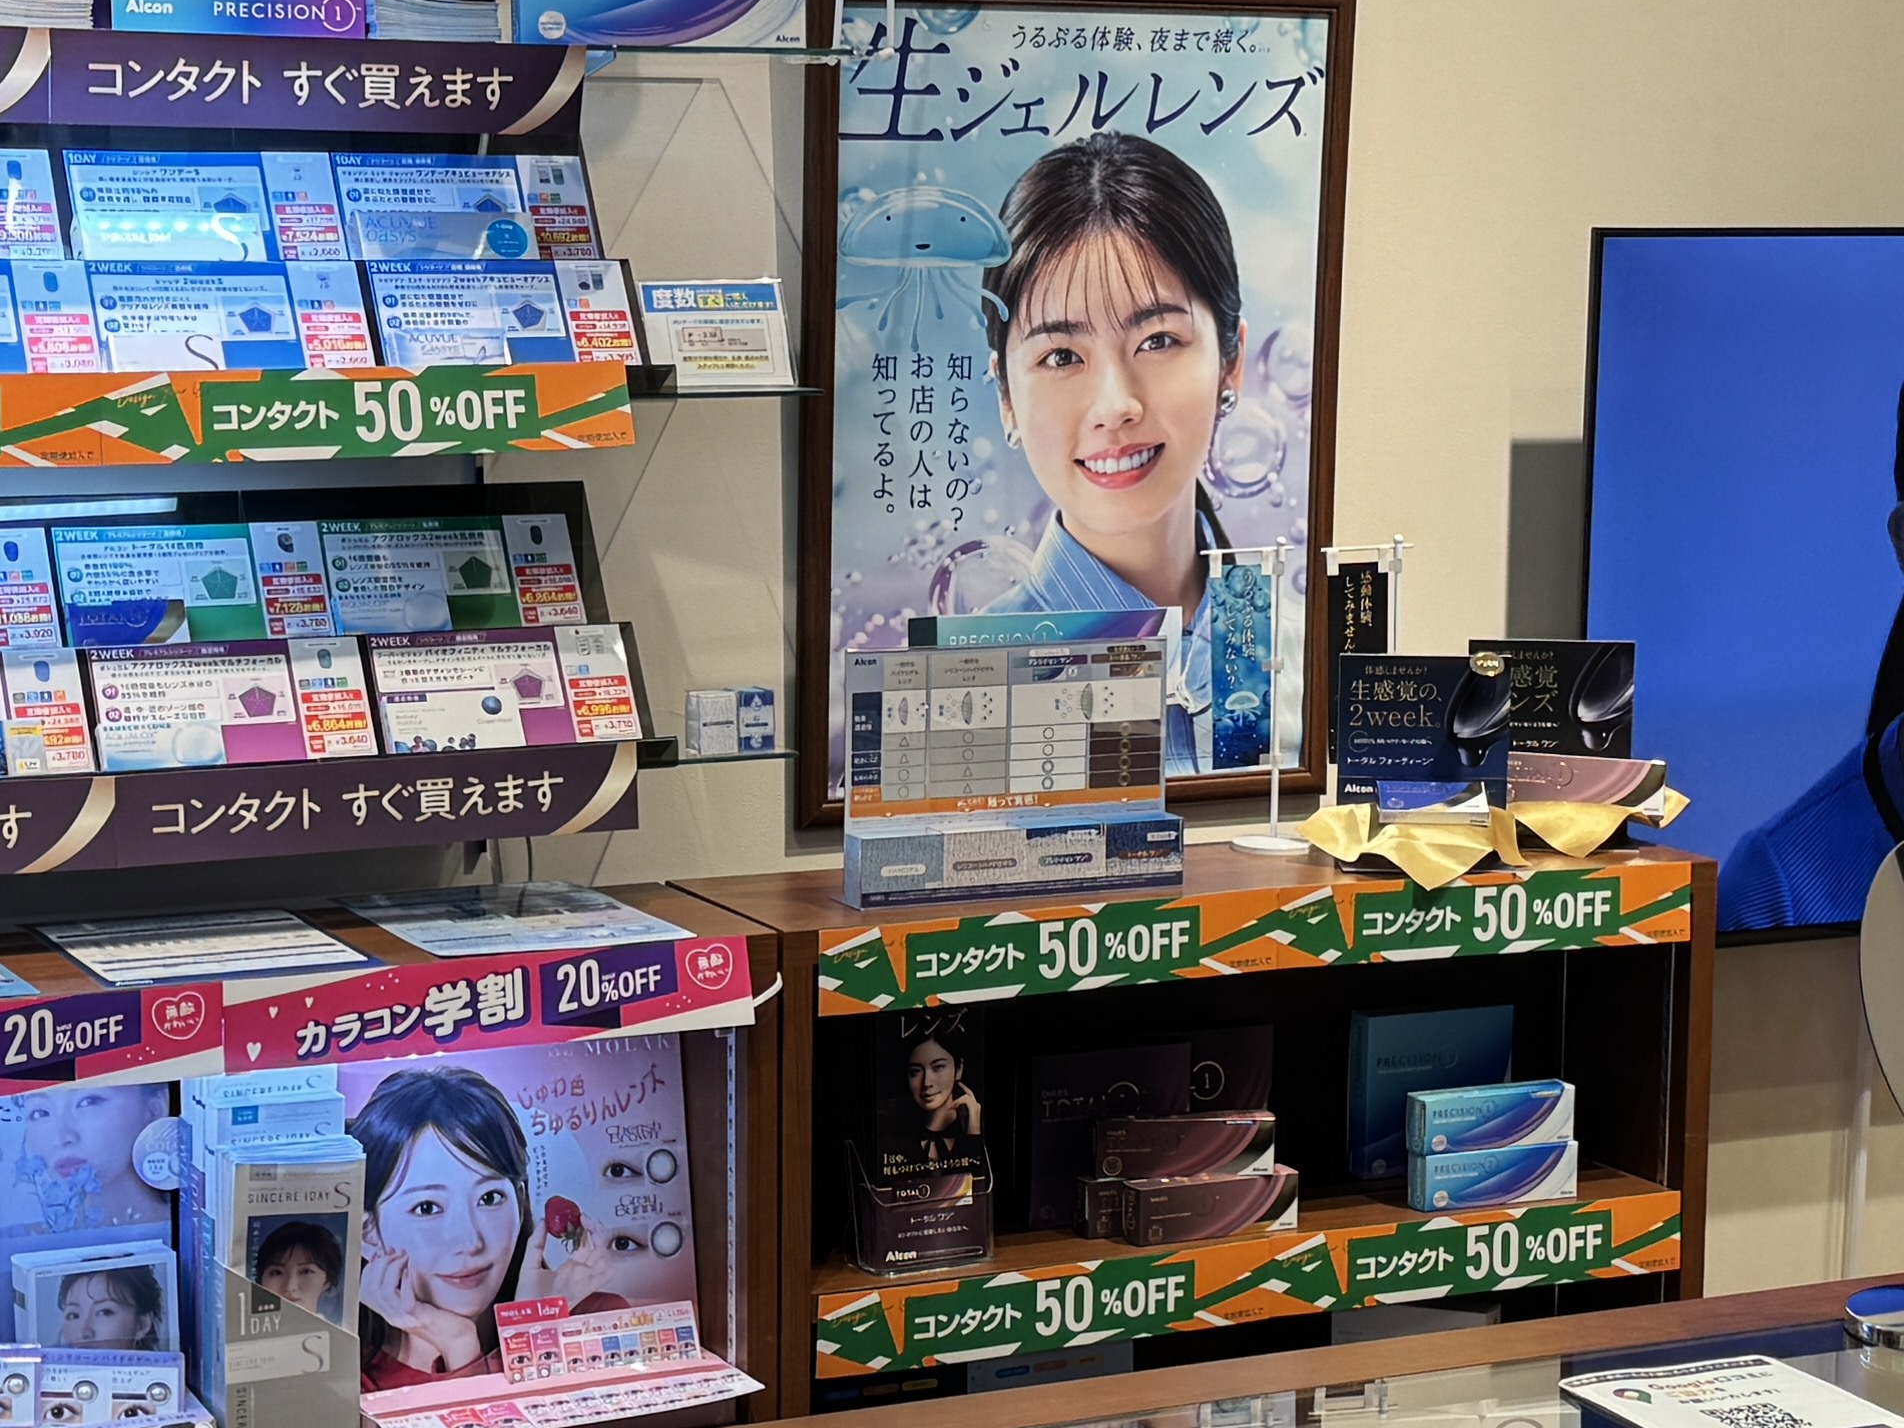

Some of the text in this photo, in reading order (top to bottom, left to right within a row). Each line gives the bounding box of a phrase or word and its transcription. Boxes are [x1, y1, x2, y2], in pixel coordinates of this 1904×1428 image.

[1010, 23, 1260, 56] うるぷる体験、夜まで続く。
[85, 56, 514, 112] コンタクト すぐ買えます
[838, 15, 1326, 143] 生ジェルレンズ
[212, 399, 340, 431] コンタクト
[908, 352, 935, 510] お店の人は
[871, 352, 898, 516] 知ってるよ。
[945, 352, 973, 533] 知らないの？
[1348, 679, 1443, 702] 生感覚の、
[151, 771, 564, 834] コンタクト すぐ買えます
[1344, 783, 1375, 795] Alcon
[1361, 904, 1462, 938] コンタクト
[915, 942, 1026, 980] コンタクト
[295, 966, 528, 1059] カラコン学割
[899, 1007, 968, 1039] レンズ
[247, 1190, 299, 1206] SINCERE
[884, 1246, 919, 1263] Alcon
[1355, 1246, 1456, 1281] コンタクト
[912, 1303, 1023, 1341] コンタクト
